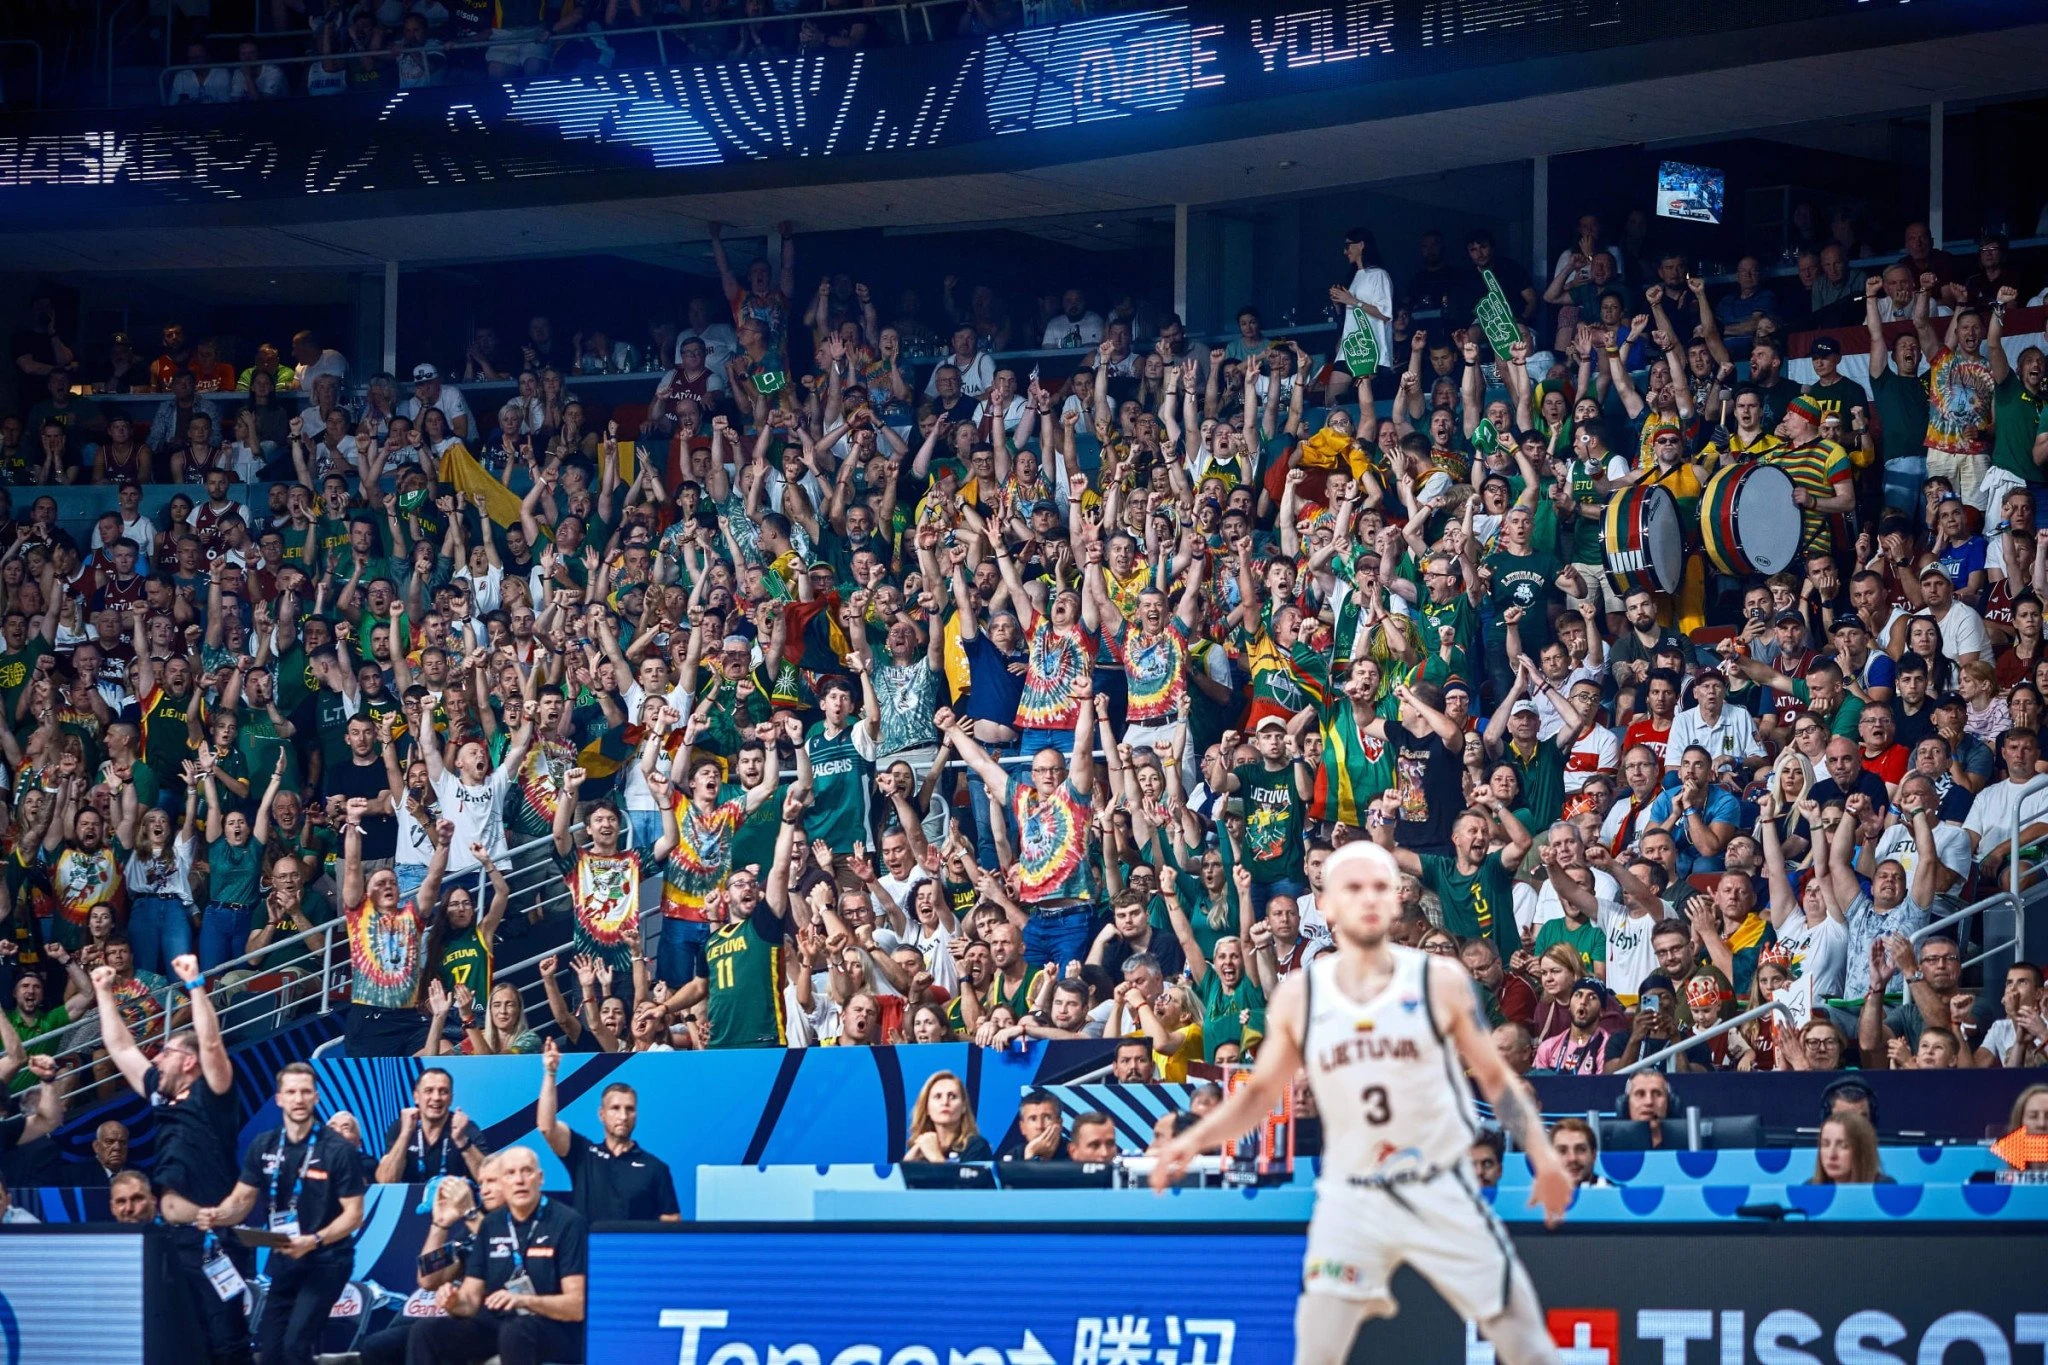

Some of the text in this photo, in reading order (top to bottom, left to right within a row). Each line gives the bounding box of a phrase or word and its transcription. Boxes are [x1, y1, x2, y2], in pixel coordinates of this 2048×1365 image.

[1250, 0, 1395, 72] YOUR
[160, 708, 188, 723] LIETU
[1250, 785, 1292, 805] LIETUVA
[1886, 840, 1910, 856] LIETU
[443, 948, 478, 964] LIETUVA
[706, 936, 748, 961] LIETUVA
[451, 963, 472, 985] 17
[716, 957, 735, 990] 11
[1318, 1037, 1420, 1073] LIETUVA
[1361, 1085, 1391, 1126] 3
